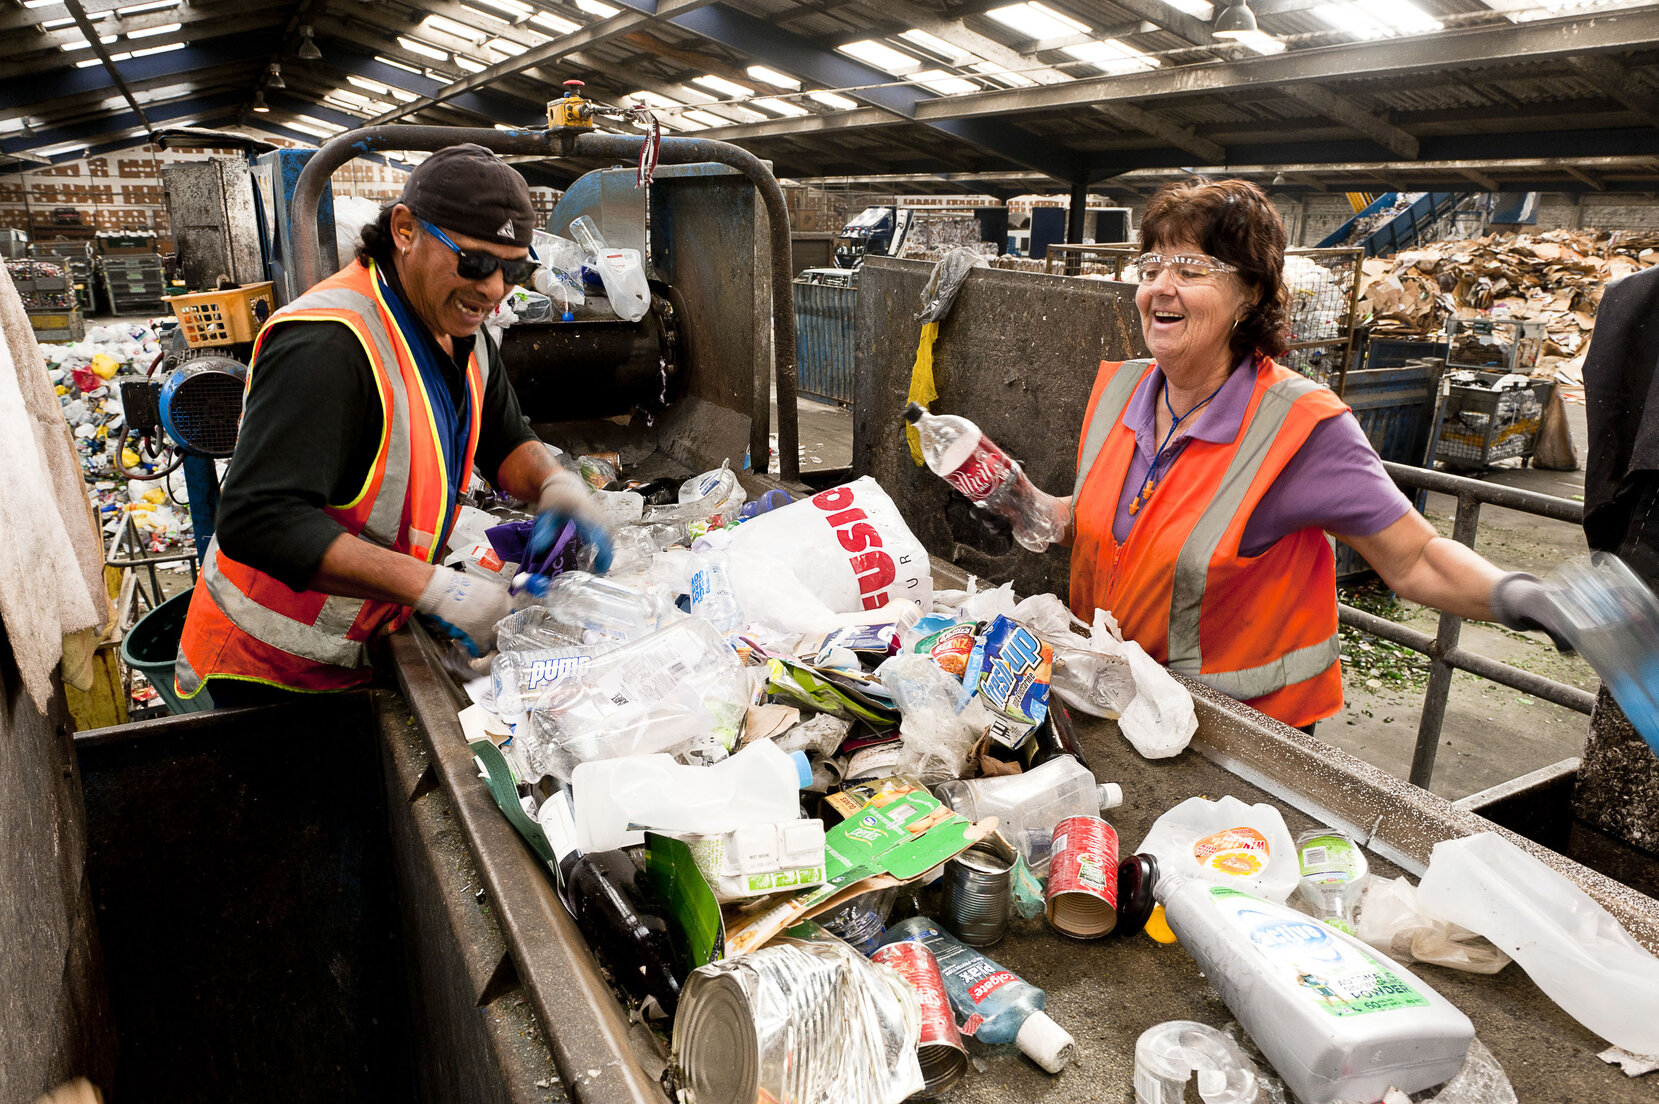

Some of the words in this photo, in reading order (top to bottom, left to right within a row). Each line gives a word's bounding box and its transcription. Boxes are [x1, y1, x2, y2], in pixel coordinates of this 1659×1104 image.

[528, 655, 592, 690] pump
[1254, 924, 1323, 947] active
[974, 973, 1015, 997] Colgate
